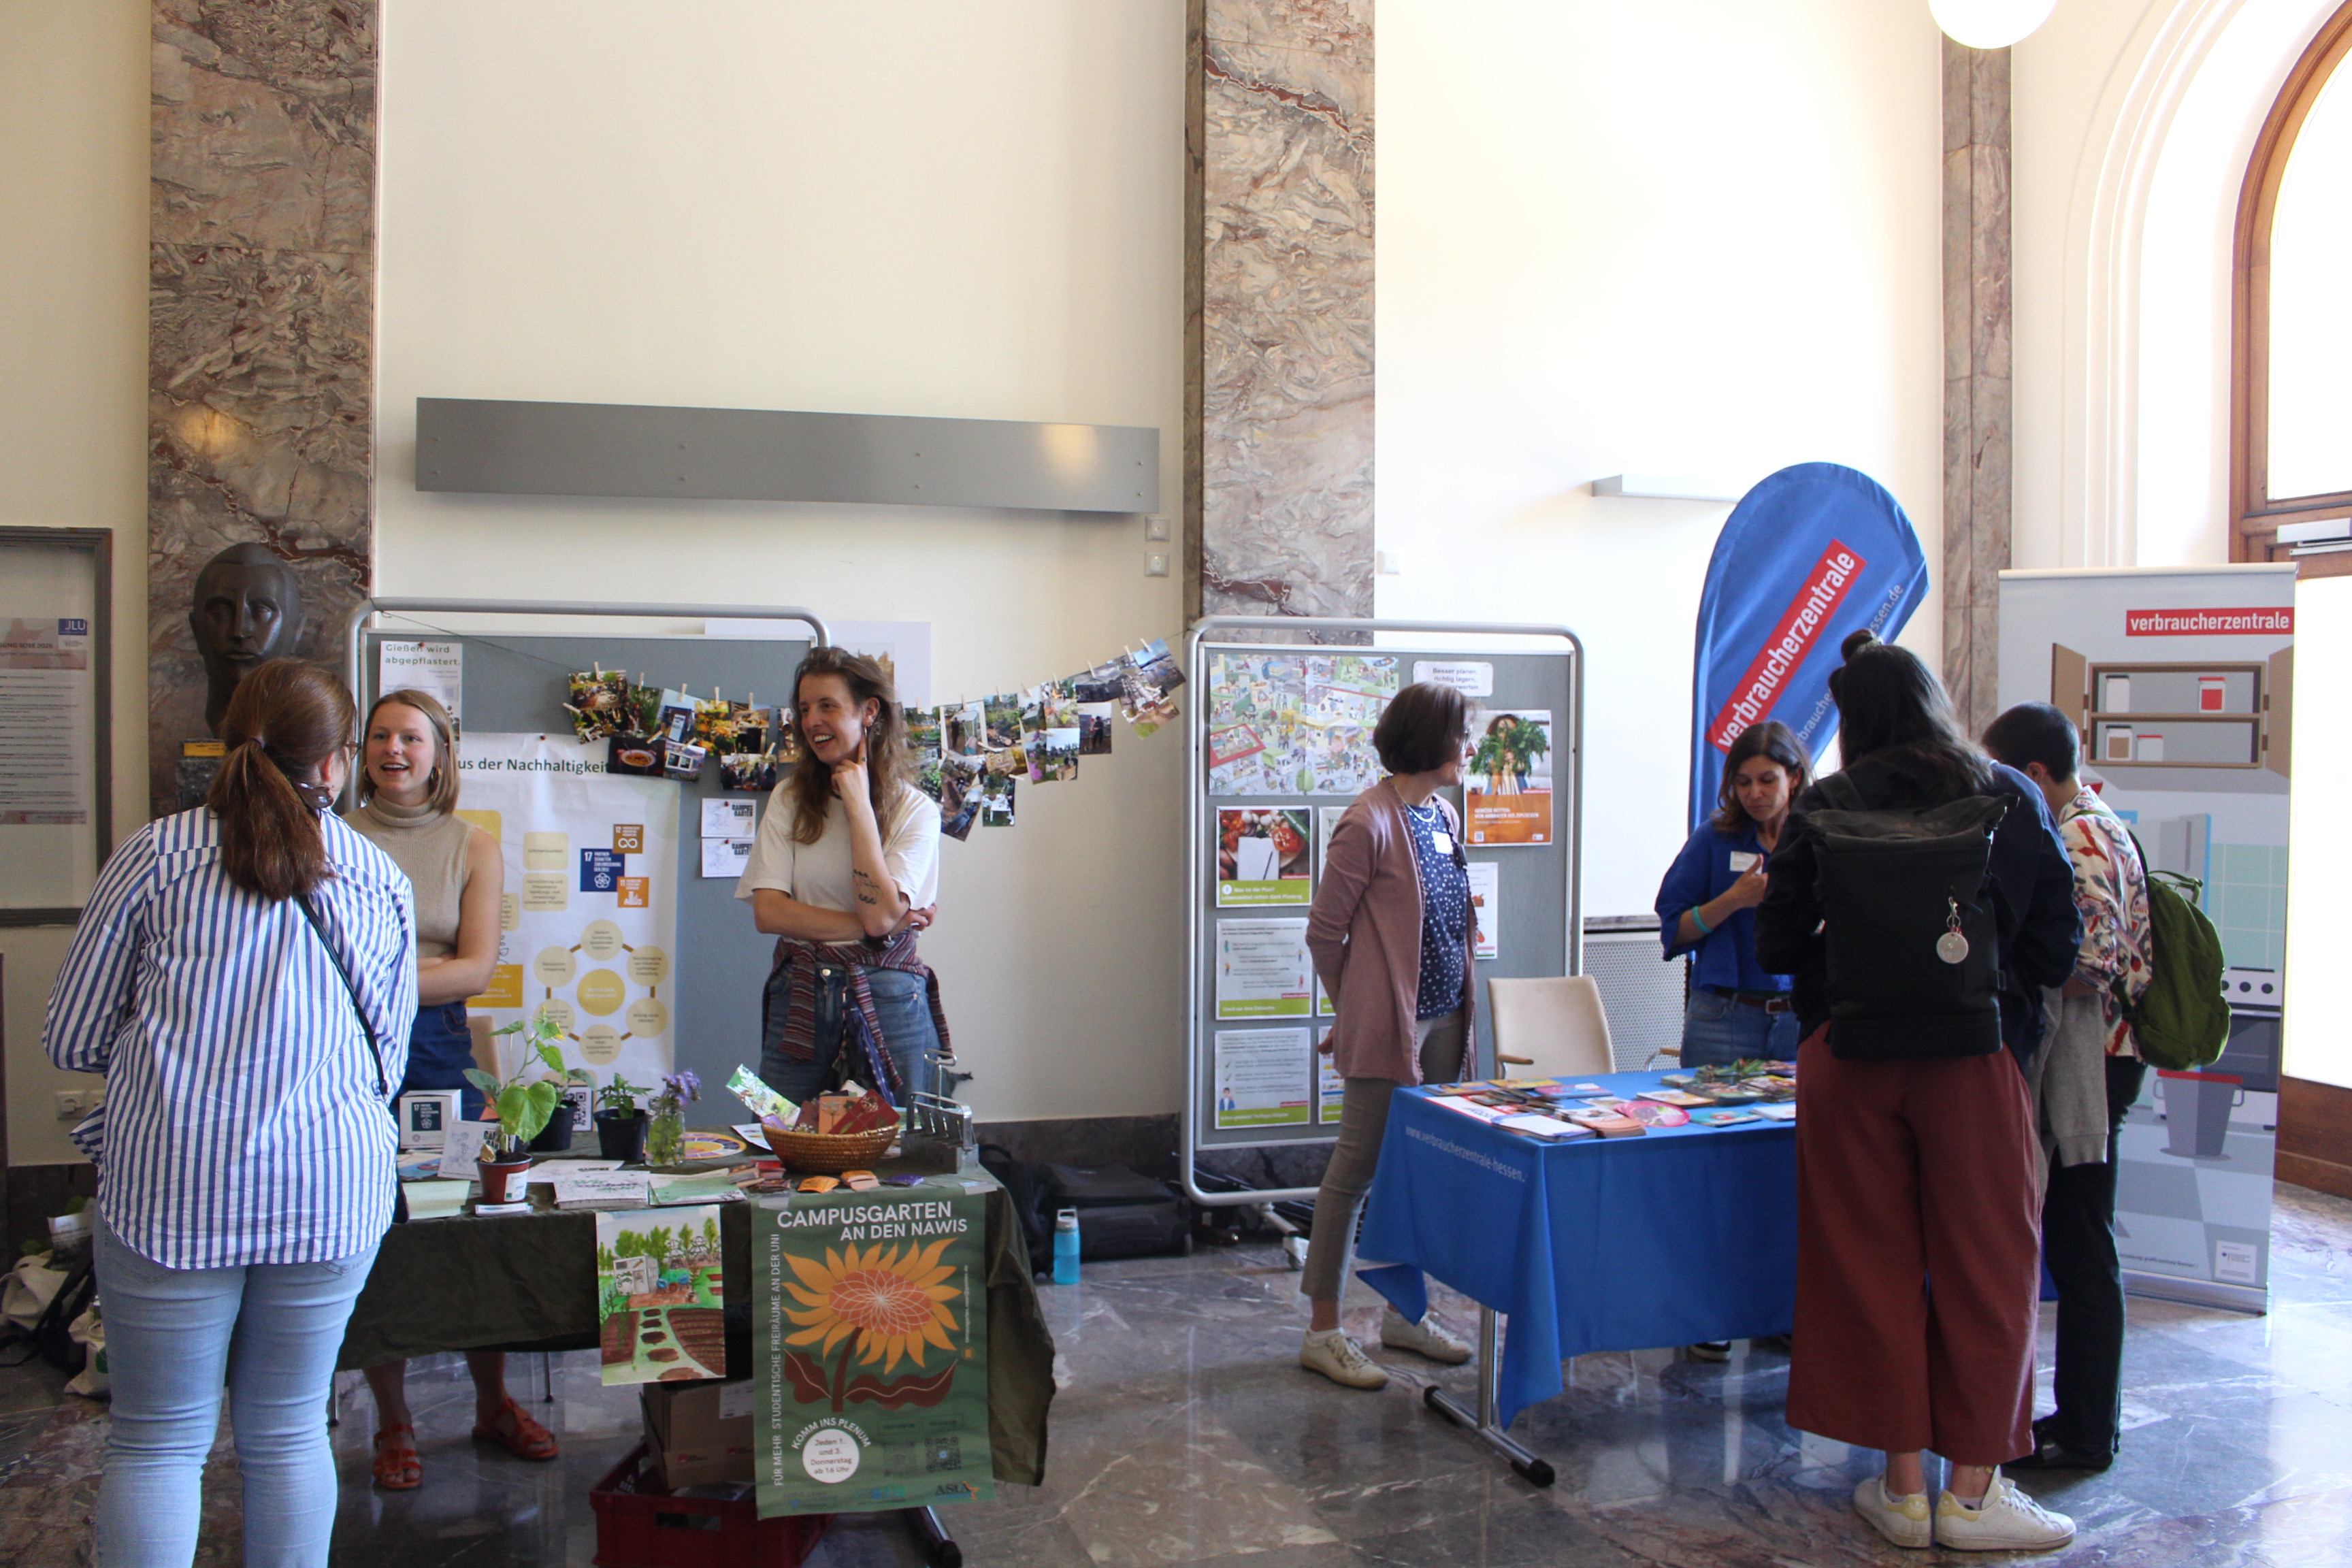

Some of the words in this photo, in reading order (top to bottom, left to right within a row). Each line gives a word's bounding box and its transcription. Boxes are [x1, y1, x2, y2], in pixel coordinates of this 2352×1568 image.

[65, 620, 86, 630] JLU
[2130, 611, 2290, 632] verbraucherzentrale
[385, 644, 423, 653] Gießen
[427, 645, 450, 653] wird
[1718, 552, 1856, 748] verbraucherzentrale
[385, 656, 461, 666] abgepflastert.
[457, 760, 474, 770] us
[478, 757, 502, 770] der
[507, 759, 609, 775] Nachhaltigkeit
[584, 851, 593, 862] 17
[1405, 1125, 1526, 1183] www.verbraucherzentrale-hessen.
[777, 1200, 952, 1228] CAMPUSGARTEN
[840, 1226, 865, 1241] AN
[870, 1224, 906, 1239] DEN
[911, 1218, 968, 1236] NAWIS
[770, 1234, 781, 1252] UNI
[770, 1254, 781, 1275] DER
[770, 1278, 781, 1292] AN
[769, 1294, 781, 1351] FREIRÄUME
[770, 1354, 782, 1429] STUDENTISCHE
[791, 1421, 819, 1450] KOMM
[819, 1417, 836, 1427] INS
[837, 1418, 872, 1448] PLENUM
[772, 1434, 782, 1466] MEHR
[810, 1457, 852, 1466] Donnerstag
[772, 1467, 783, 1486] FÜR
